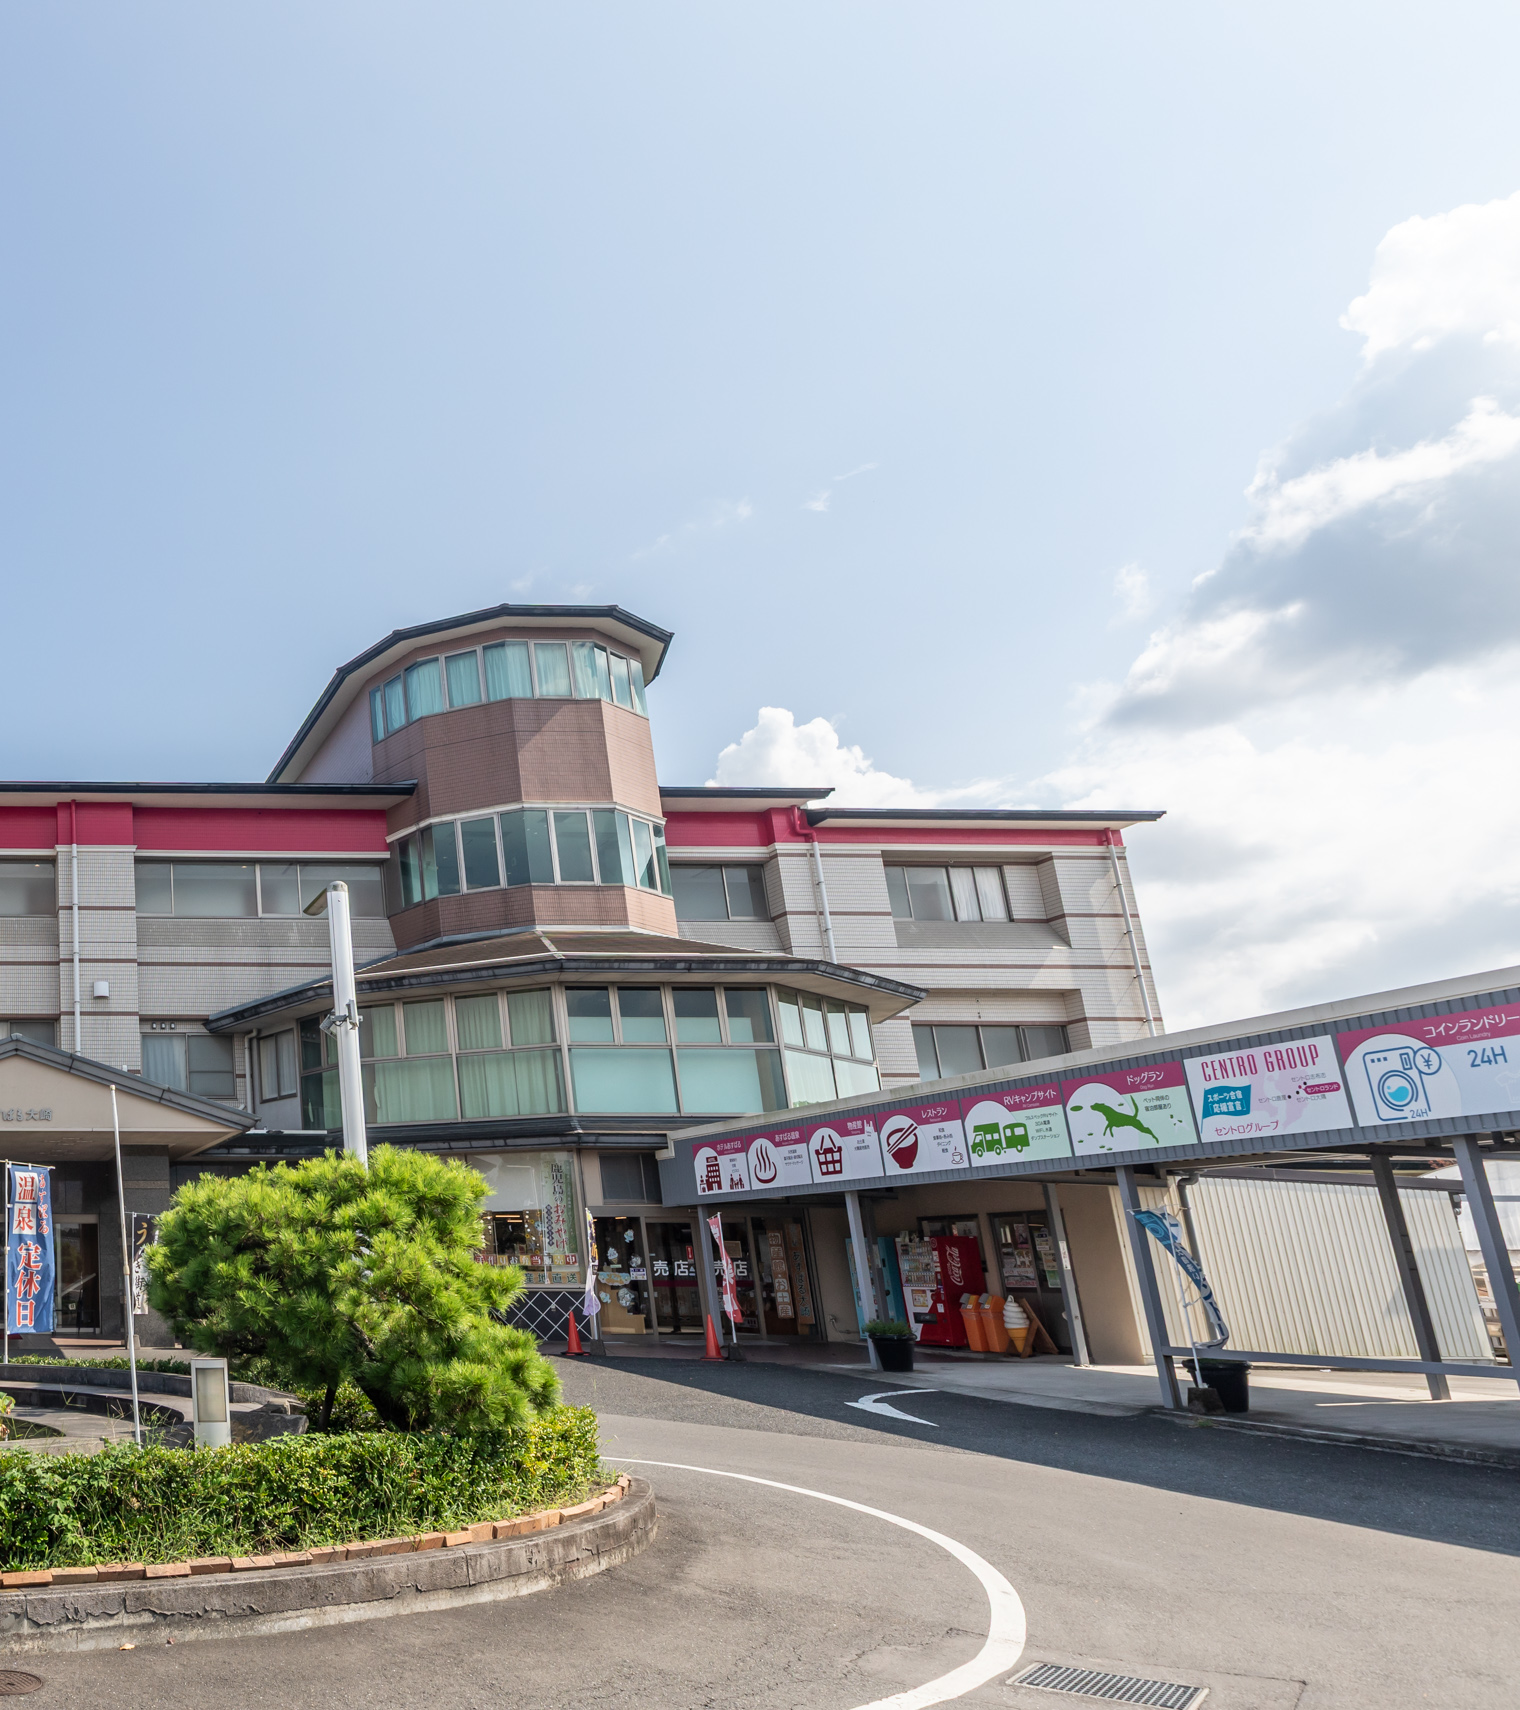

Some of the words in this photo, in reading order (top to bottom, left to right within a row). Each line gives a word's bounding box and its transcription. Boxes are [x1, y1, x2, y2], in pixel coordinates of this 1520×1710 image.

[1423, 1013, 1520, 1038] コインランドリー
[1471, 1031, 1491, 1039] Laundry
[1201, 1053, 1258, 1082] CENTRO
[1263, 1044, 1319, 1073] GROUP
[1467, 1045, 1508, 1068] 24H
[1126, 1071, 1164, 1086] ドッグラン
[1207, 1090, 1243, 1102] スポーツ合宿
[1306, 1083, 1339, 1094] セントロランド
[1003, 1089, 1057, 1106] RVキャンプサイト
[921, 1107, 948, 1118] レストラン
[1409, 1108, 1429, 1119] 24H
[1214, 1120, 1279, 1136] セントログループ
[716, 1141, 742, 1151] ホテルあすばる
[14, 1175, 36, 1232] 温泉
[653, 1260, 688, 1276] 売店
[15, 1242, 42, 1327] 定休日
